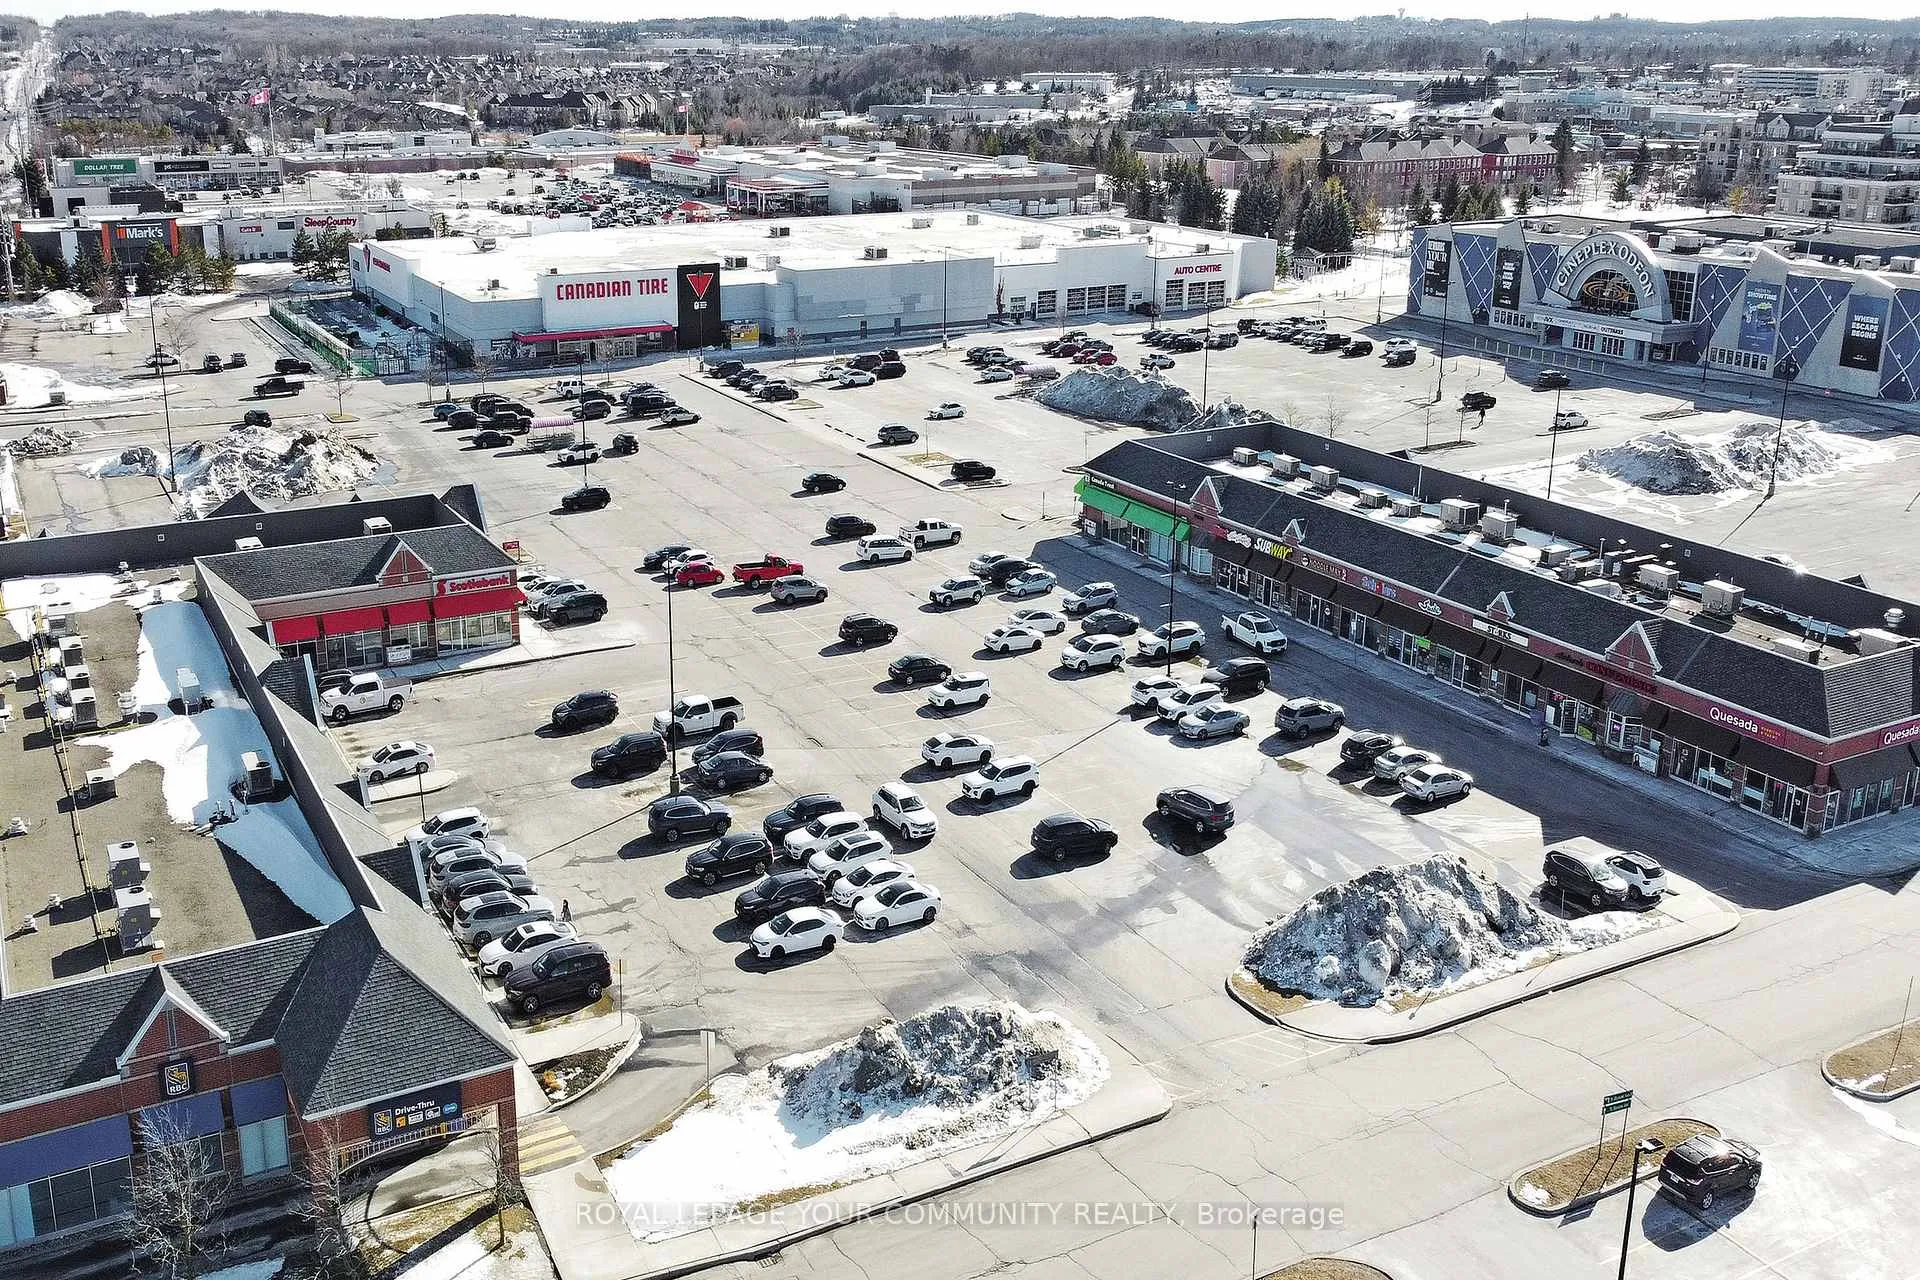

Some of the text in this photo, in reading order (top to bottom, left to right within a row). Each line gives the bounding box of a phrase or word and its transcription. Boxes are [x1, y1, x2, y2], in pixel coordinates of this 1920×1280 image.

[125, 226, 164, 239] Mark's
[1174, 264, 1222, 275] AUTO CENTRE
[1557, 241, 1617, 287] CINEPLEX
[1618, 245, 1655, 298] ODEON
[556, 278, 669, 301] CANADIAN TIRE
[1851, 322, 1879, 332] ESCAPE
[1854, 314, 1880, 325] WHERE
[1851, 330, 1877, 340] BEGINS
[1254, 537, 1290, 559] SUBWAY
[450, 574, 509, 592] Scotiabank
[1709, 707, 1758, 734] Quesada
[1884, 725, 1919, 745] Quesada
[169, 1083, 187, 1093] RBC
[395, 1100, 435, 1115] Drive-Thru
